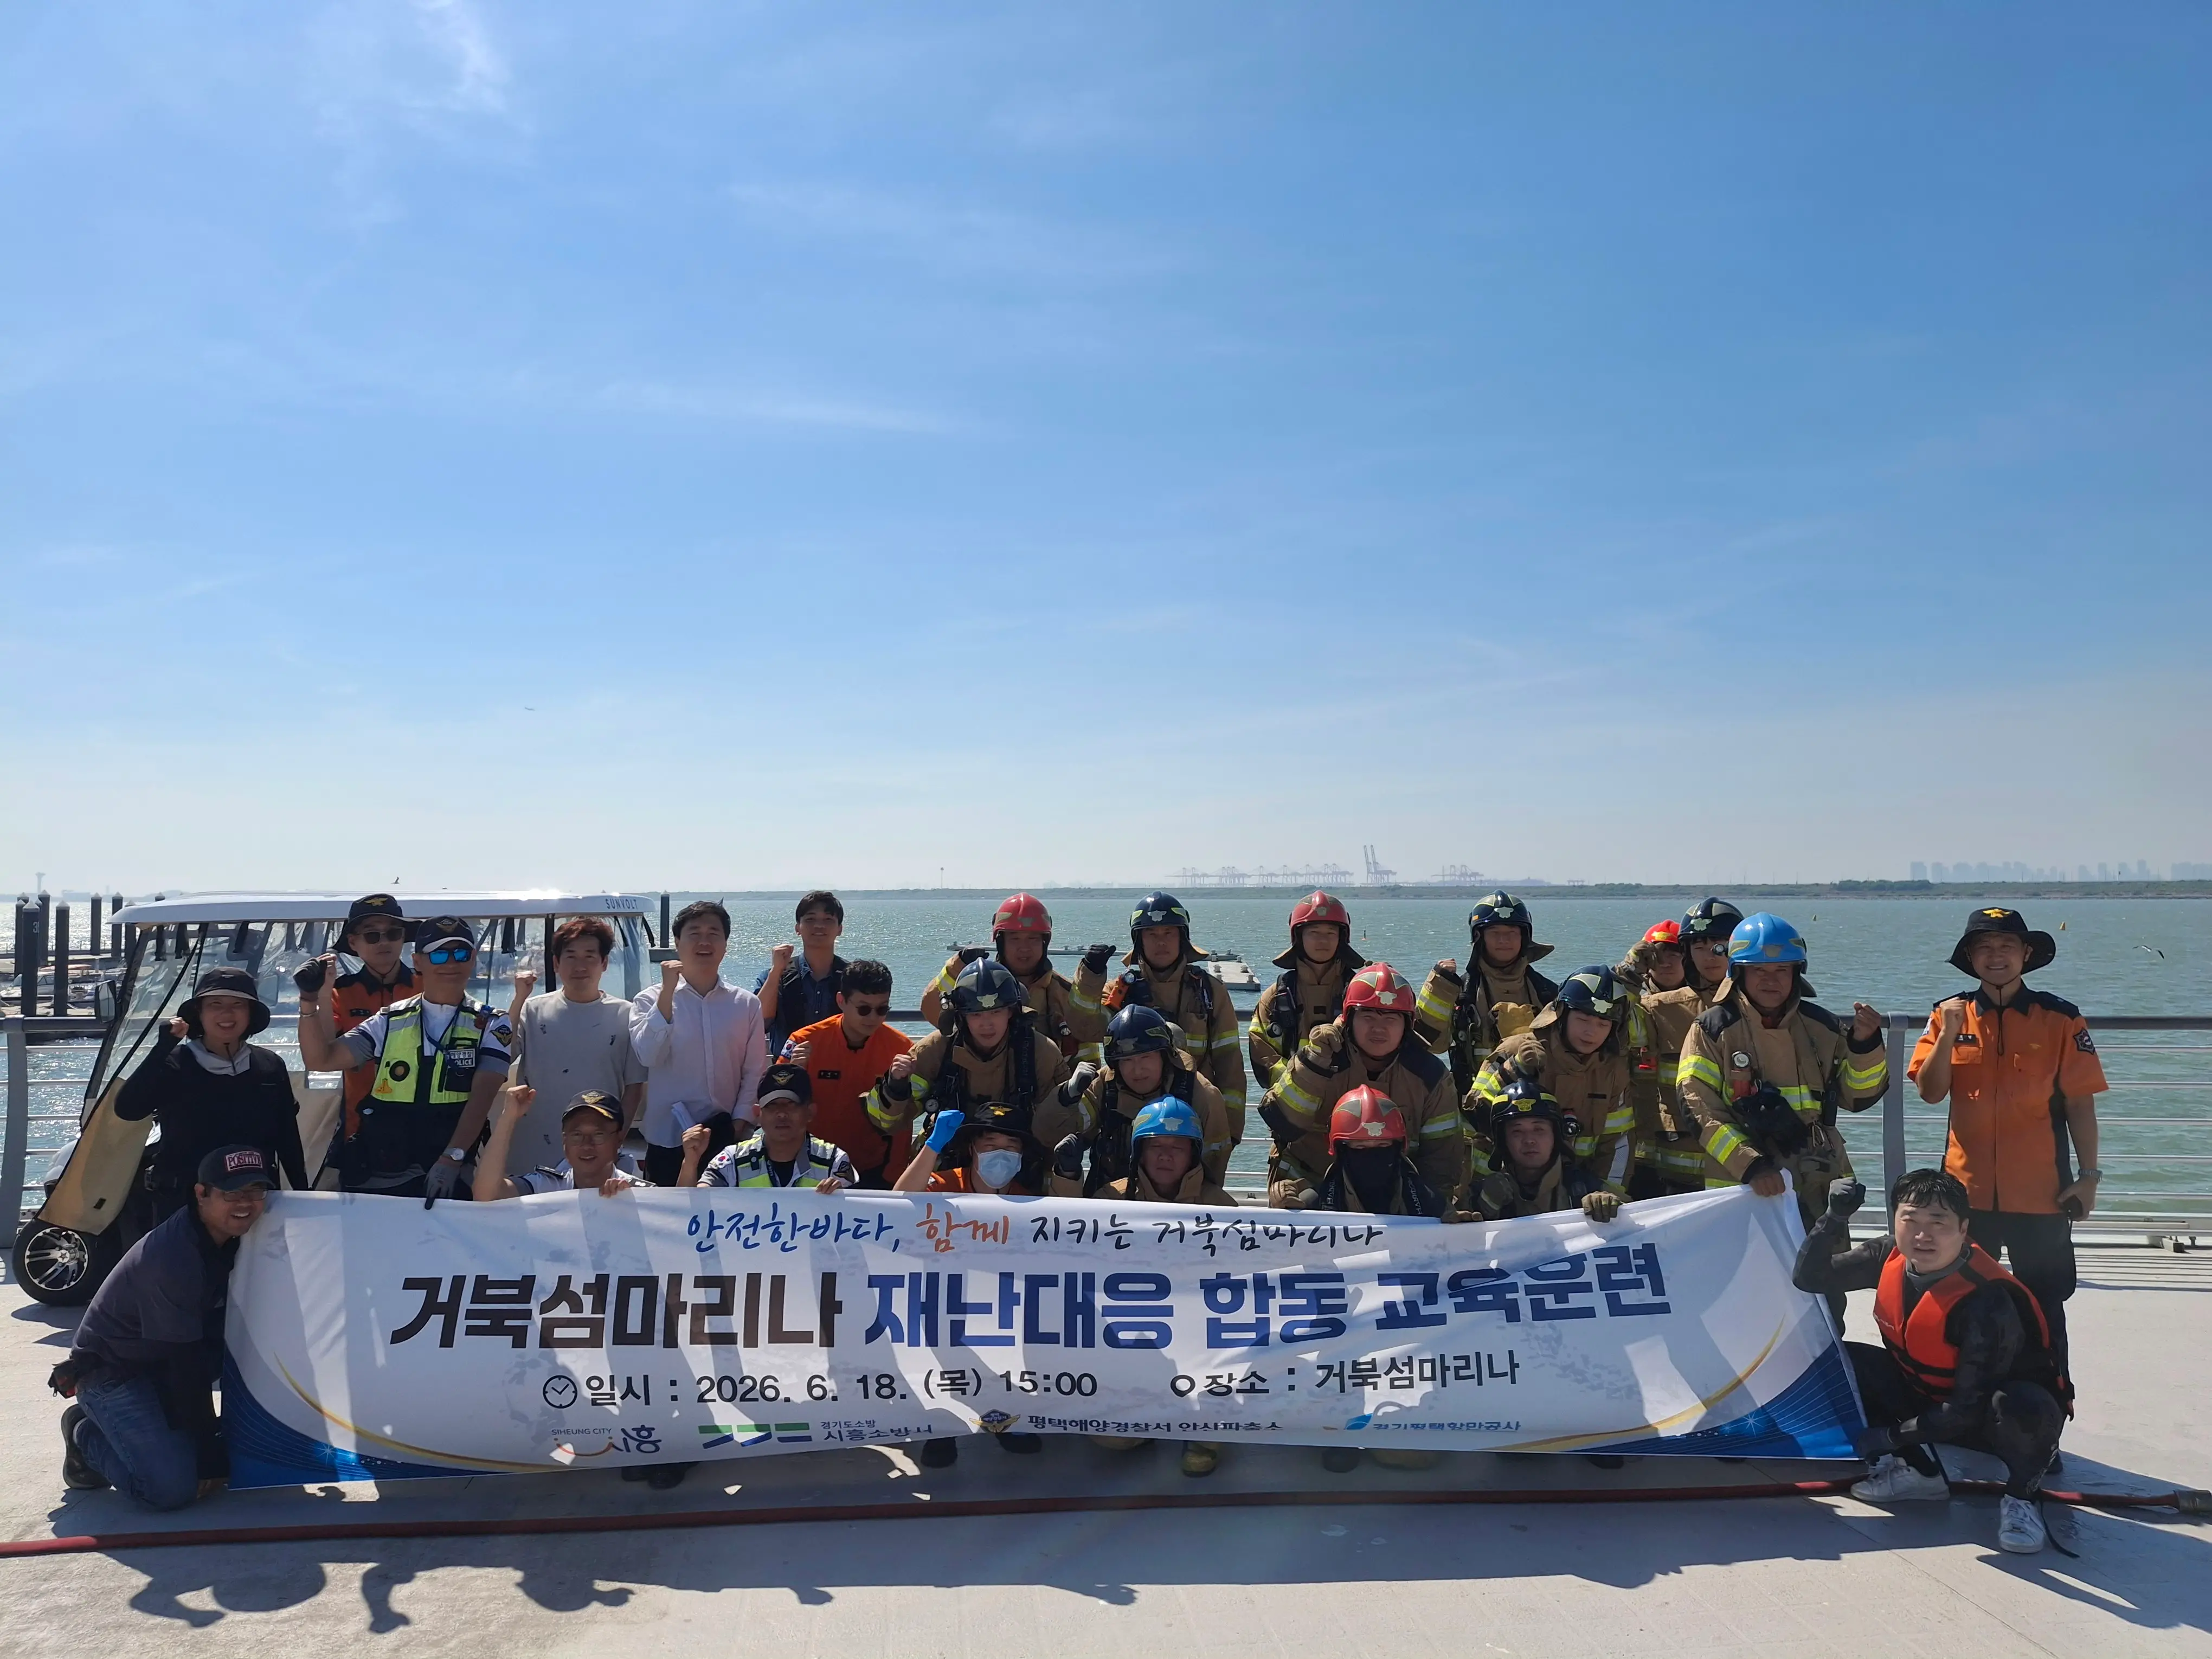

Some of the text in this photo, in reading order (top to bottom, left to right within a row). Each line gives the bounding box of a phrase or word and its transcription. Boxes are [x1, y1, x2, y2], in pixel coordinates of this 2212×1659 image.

[605, 898, 638, 909] SUNVOLT
[228, 1154, 261, 1166] POSITIVE
[687, 1202, 1384, 1257] 안전한바다, 함께 지키는 거북섬마리나
[390, 1272, 843, 1348] 거북섬마리나
[865, 1272, 1174, 1349] 재난대응
[1199, 1272, 1348, 1349] 합동
[586, 1374, 651, 1406] 일시
[696, 1375, 791, 1403] 2026.
[806, 1374, 839, 1401] 6.
[856, 1373, 906, 1400] 18.
[924, 1368, 982, 1399] (목)
[999, 1371, 1097, 1397] 15:00
[1205, 1371, 1270, 1397] 장소
[1315, 1350, 1520, 1393] 거북섬마리나
[821, 1419, 876, 1430] 경기도소방
[1028, 1416, 1172, 1432] 평택해양경찰서
